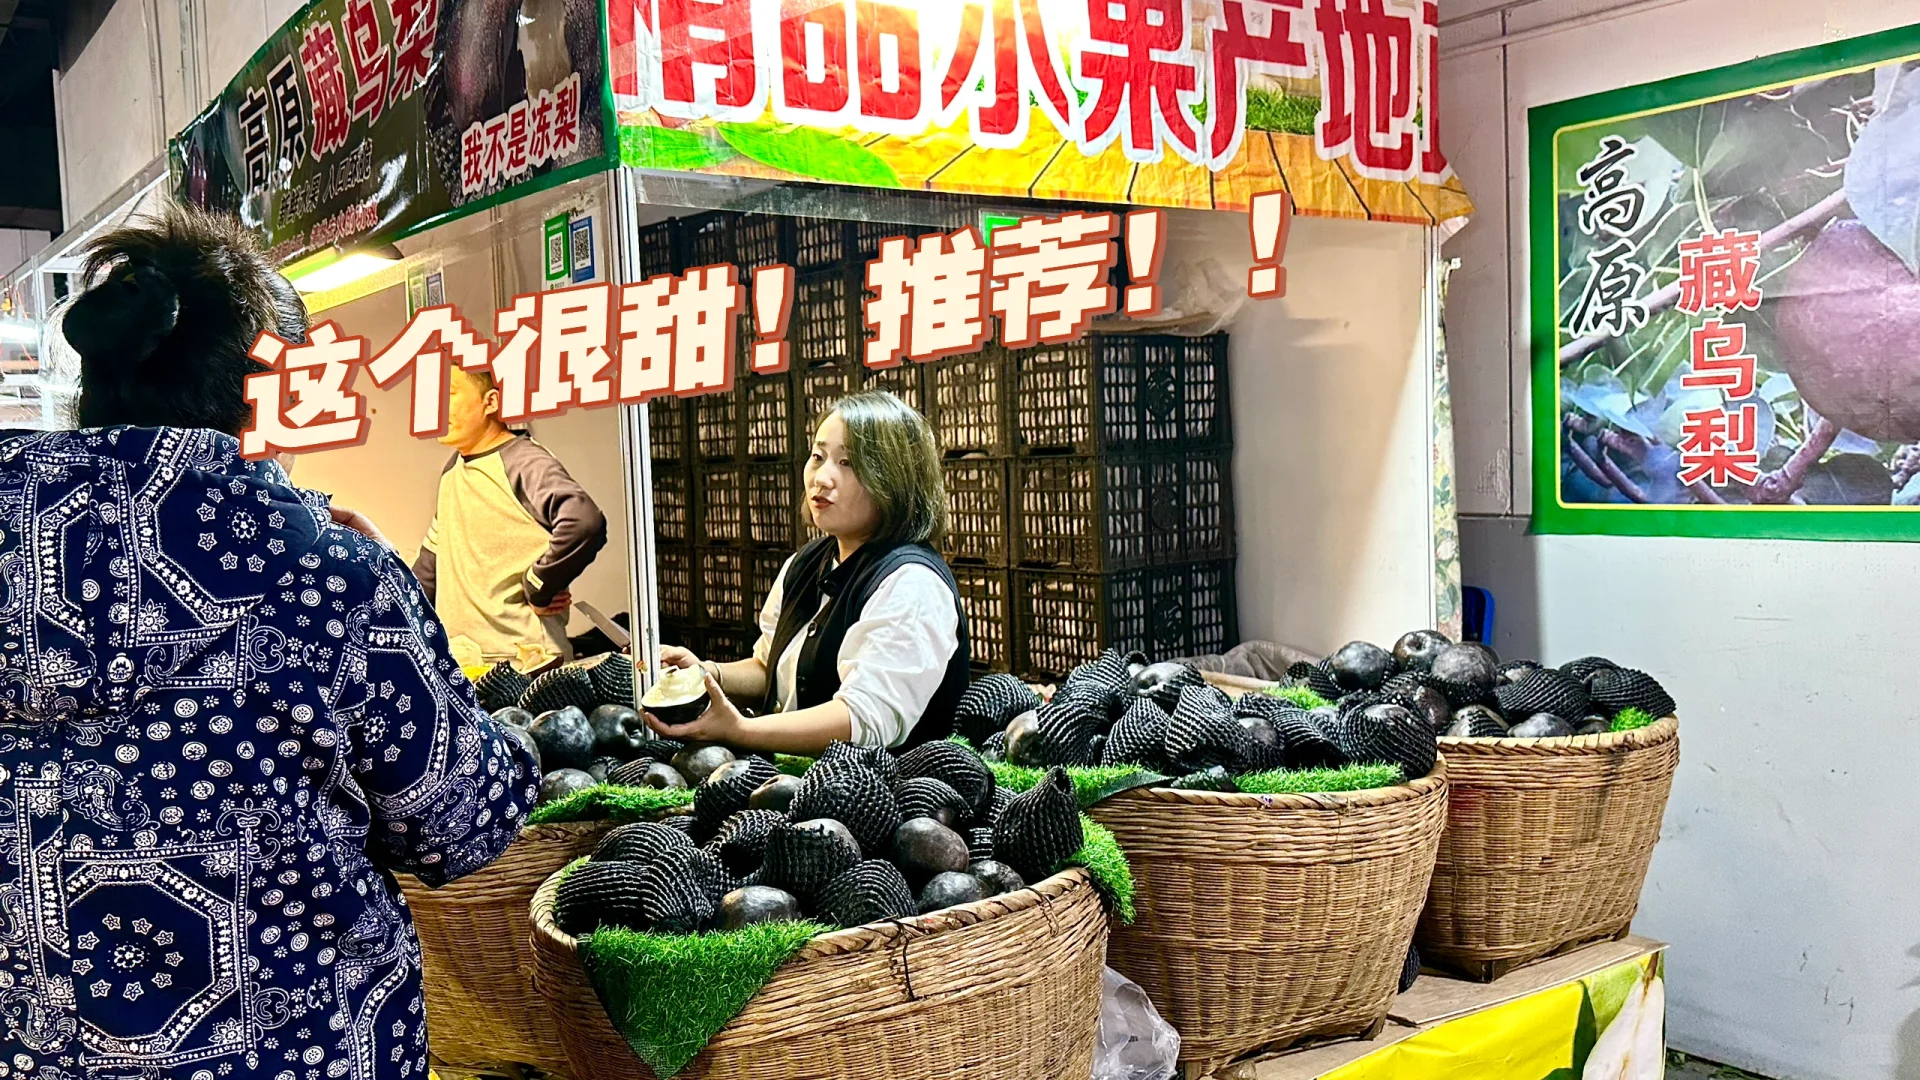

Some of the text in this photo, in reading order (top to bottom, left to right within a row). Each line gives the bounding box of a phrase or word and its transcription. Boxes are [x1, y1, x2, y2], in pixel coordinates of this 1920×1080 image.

[239, 0, 438, 196] 高原藏乌梨
[462, 76, 579, 191] 我不是冻梨
[1570, 136, 1649, 338] 高原
[1677, 228, 1762, 487] 藏乌梨
